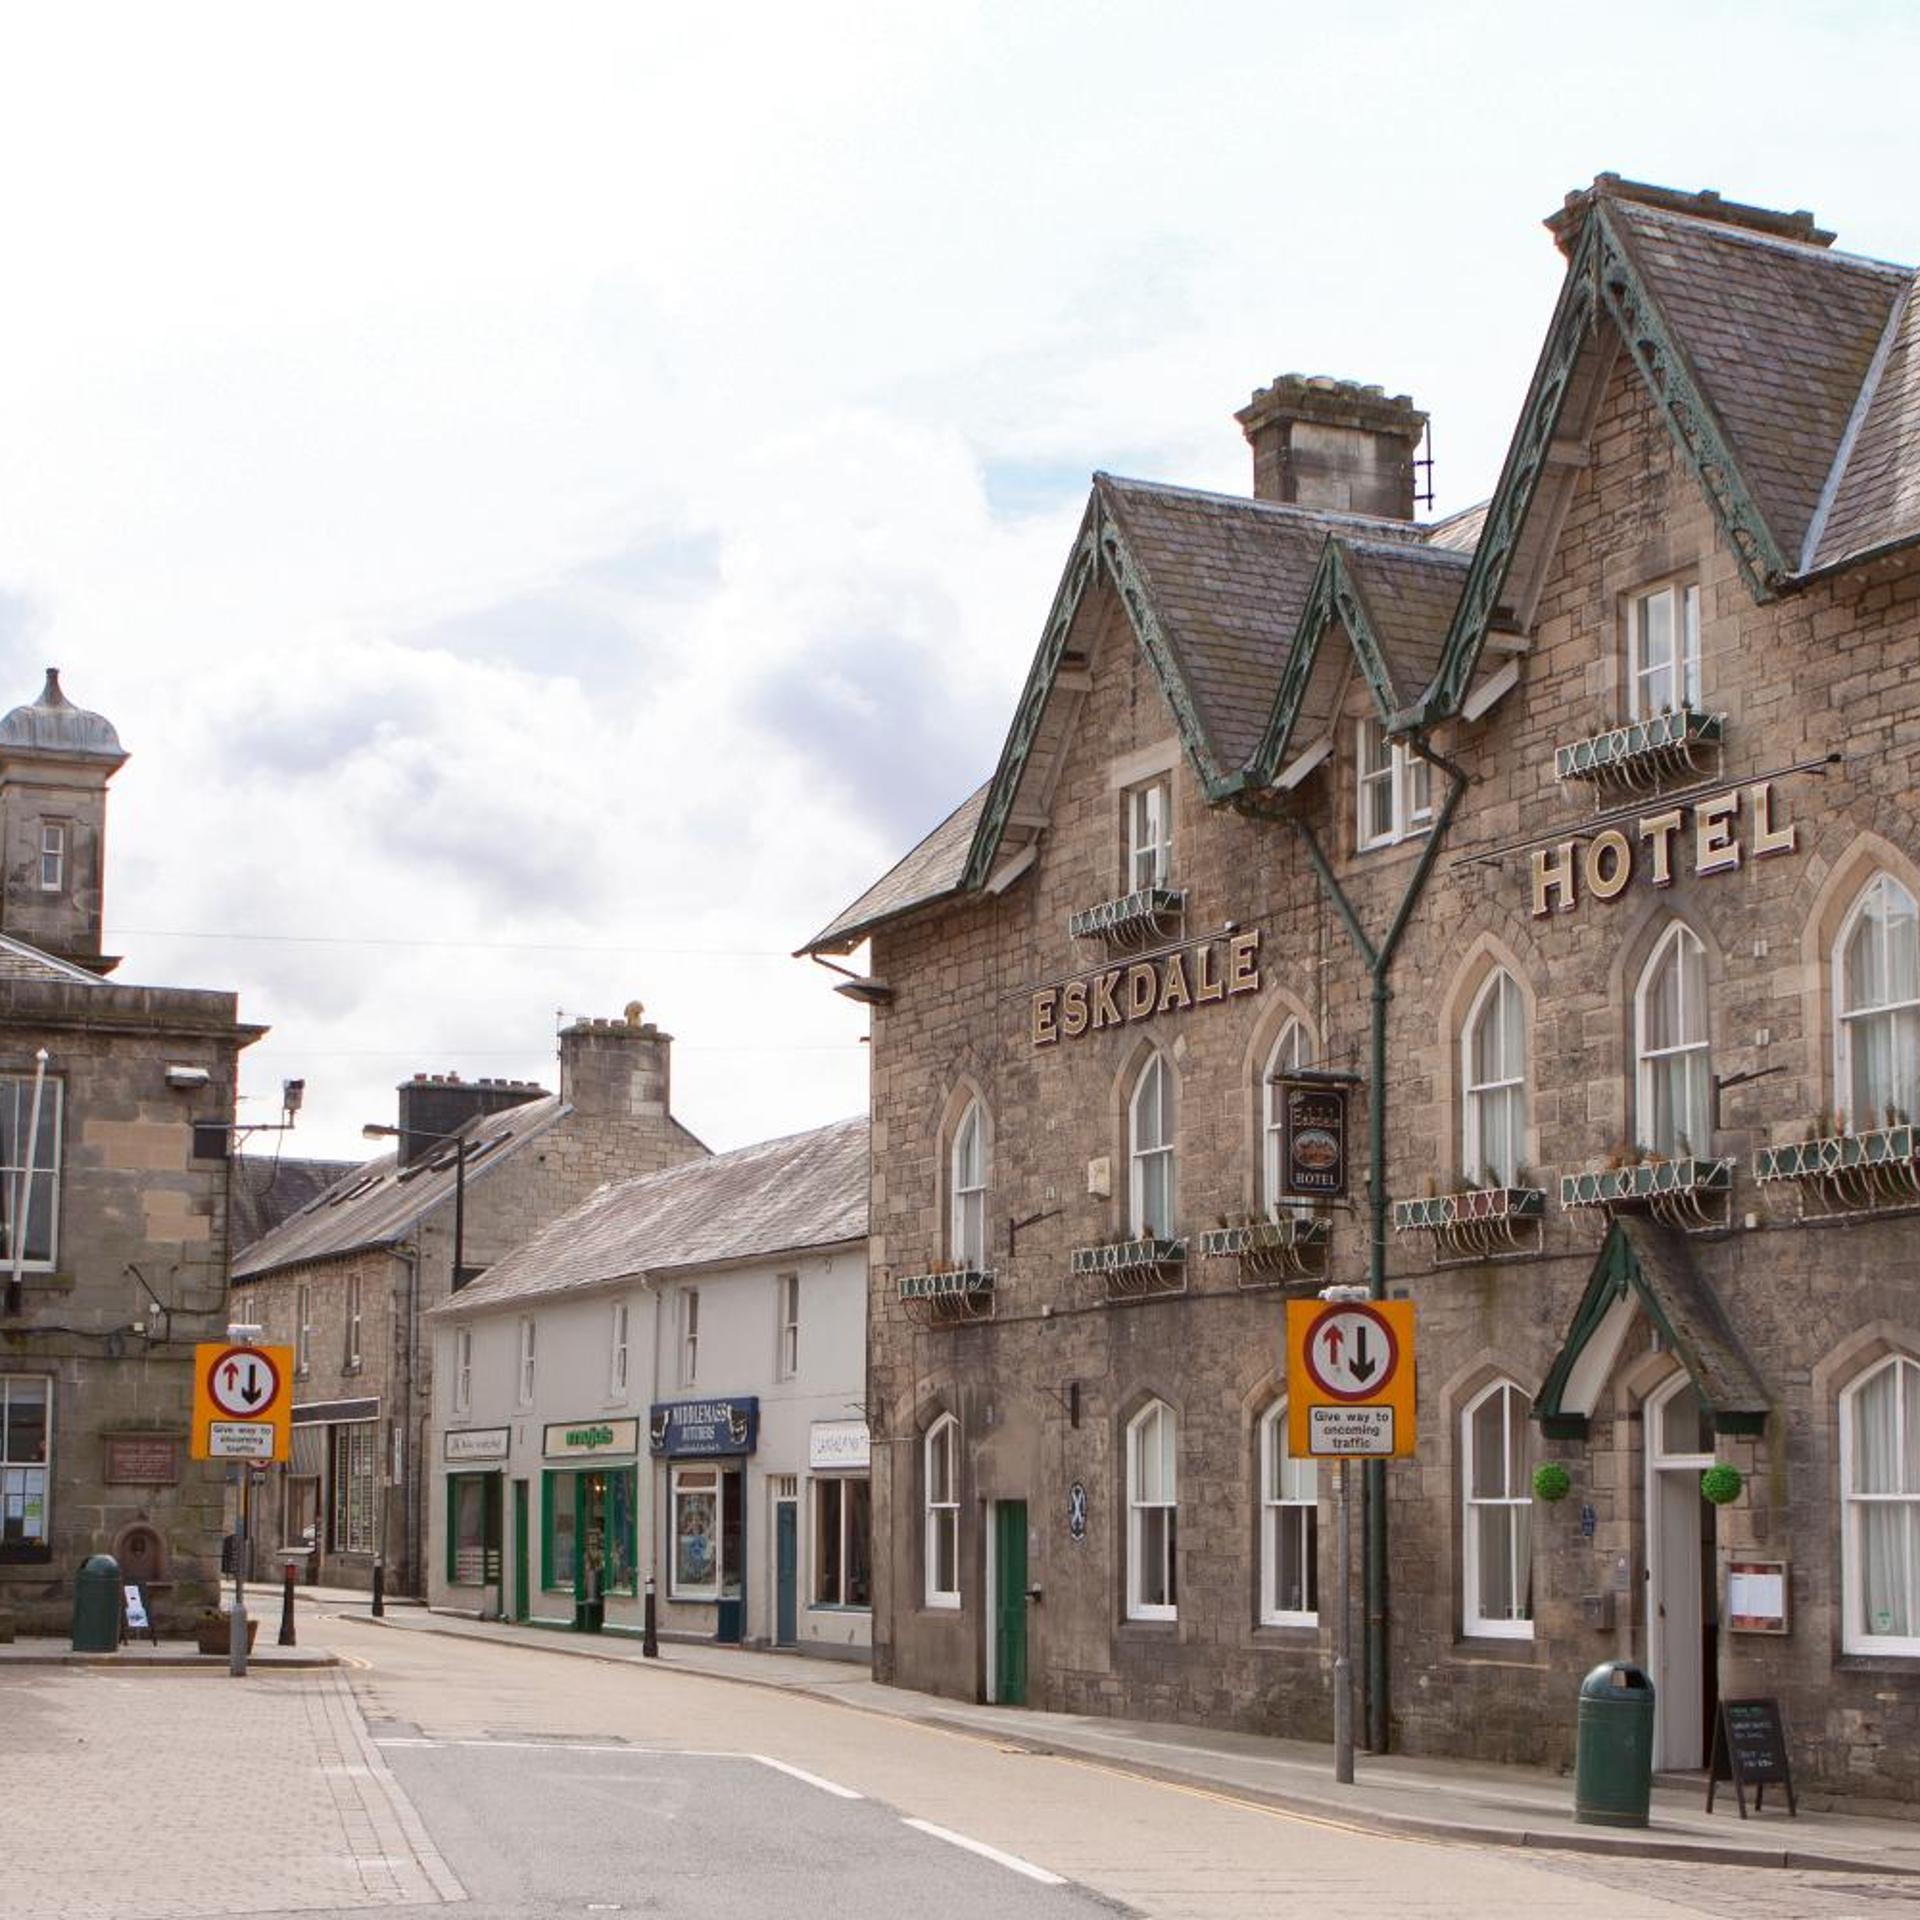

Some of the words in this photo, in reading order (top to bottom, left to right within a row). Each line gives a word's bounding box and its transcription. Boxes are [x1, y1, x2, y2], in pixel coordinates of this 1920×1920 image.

[1032, 929, 1260, 1046] ESKDALE
[1531, 782, 1797, 919] HOTEL
[1295, 1172, 1336, 1186] HOTEL
[1314, 1410, 1341, 1422] Give
[1346, 1412, 1371, 1424] way
[1376, 1411, 1389, 1422] to
[1323, 1425, 1380, 1437] oncoming
[1332, 1437, 1371, 1449] traffic
